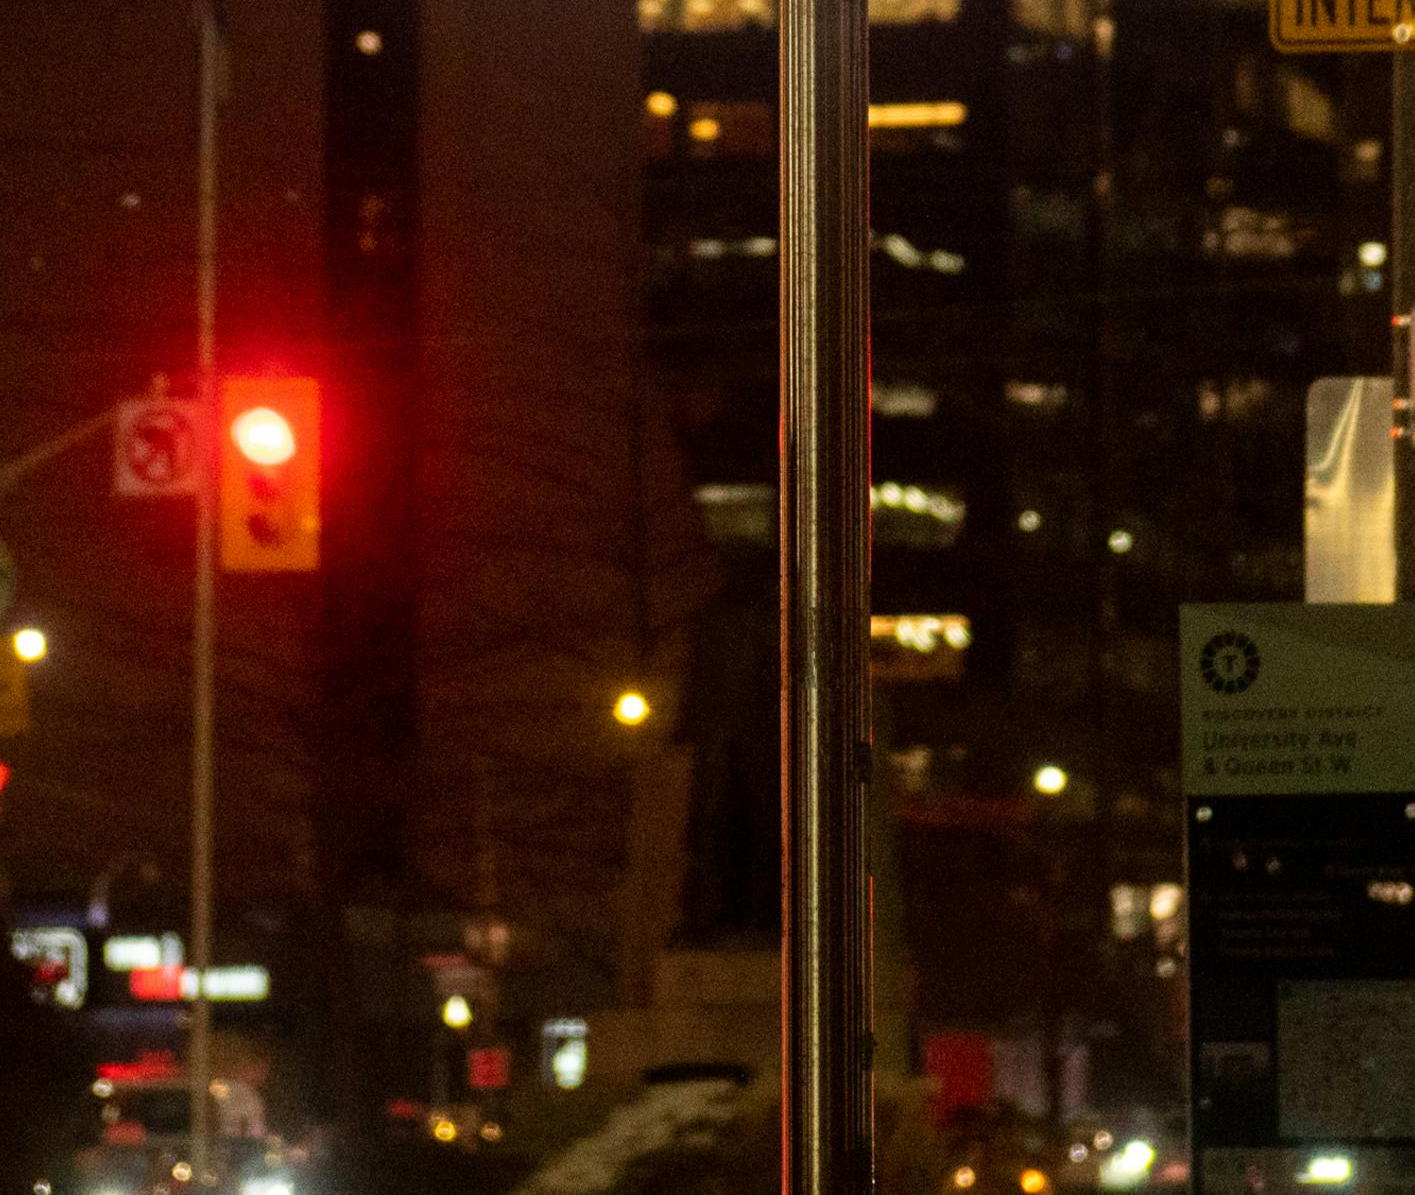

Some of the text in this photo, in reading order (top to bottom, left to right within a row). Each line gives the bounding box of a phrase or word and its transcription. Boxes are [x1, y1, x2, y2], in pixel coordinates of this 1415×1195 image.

[1202, 728, 1358, 752] University Ave
[1224, 756, 1295, 777] Queen
[1300, 754, 1322, 775] St
[1329, 754, 1352, 774] W
